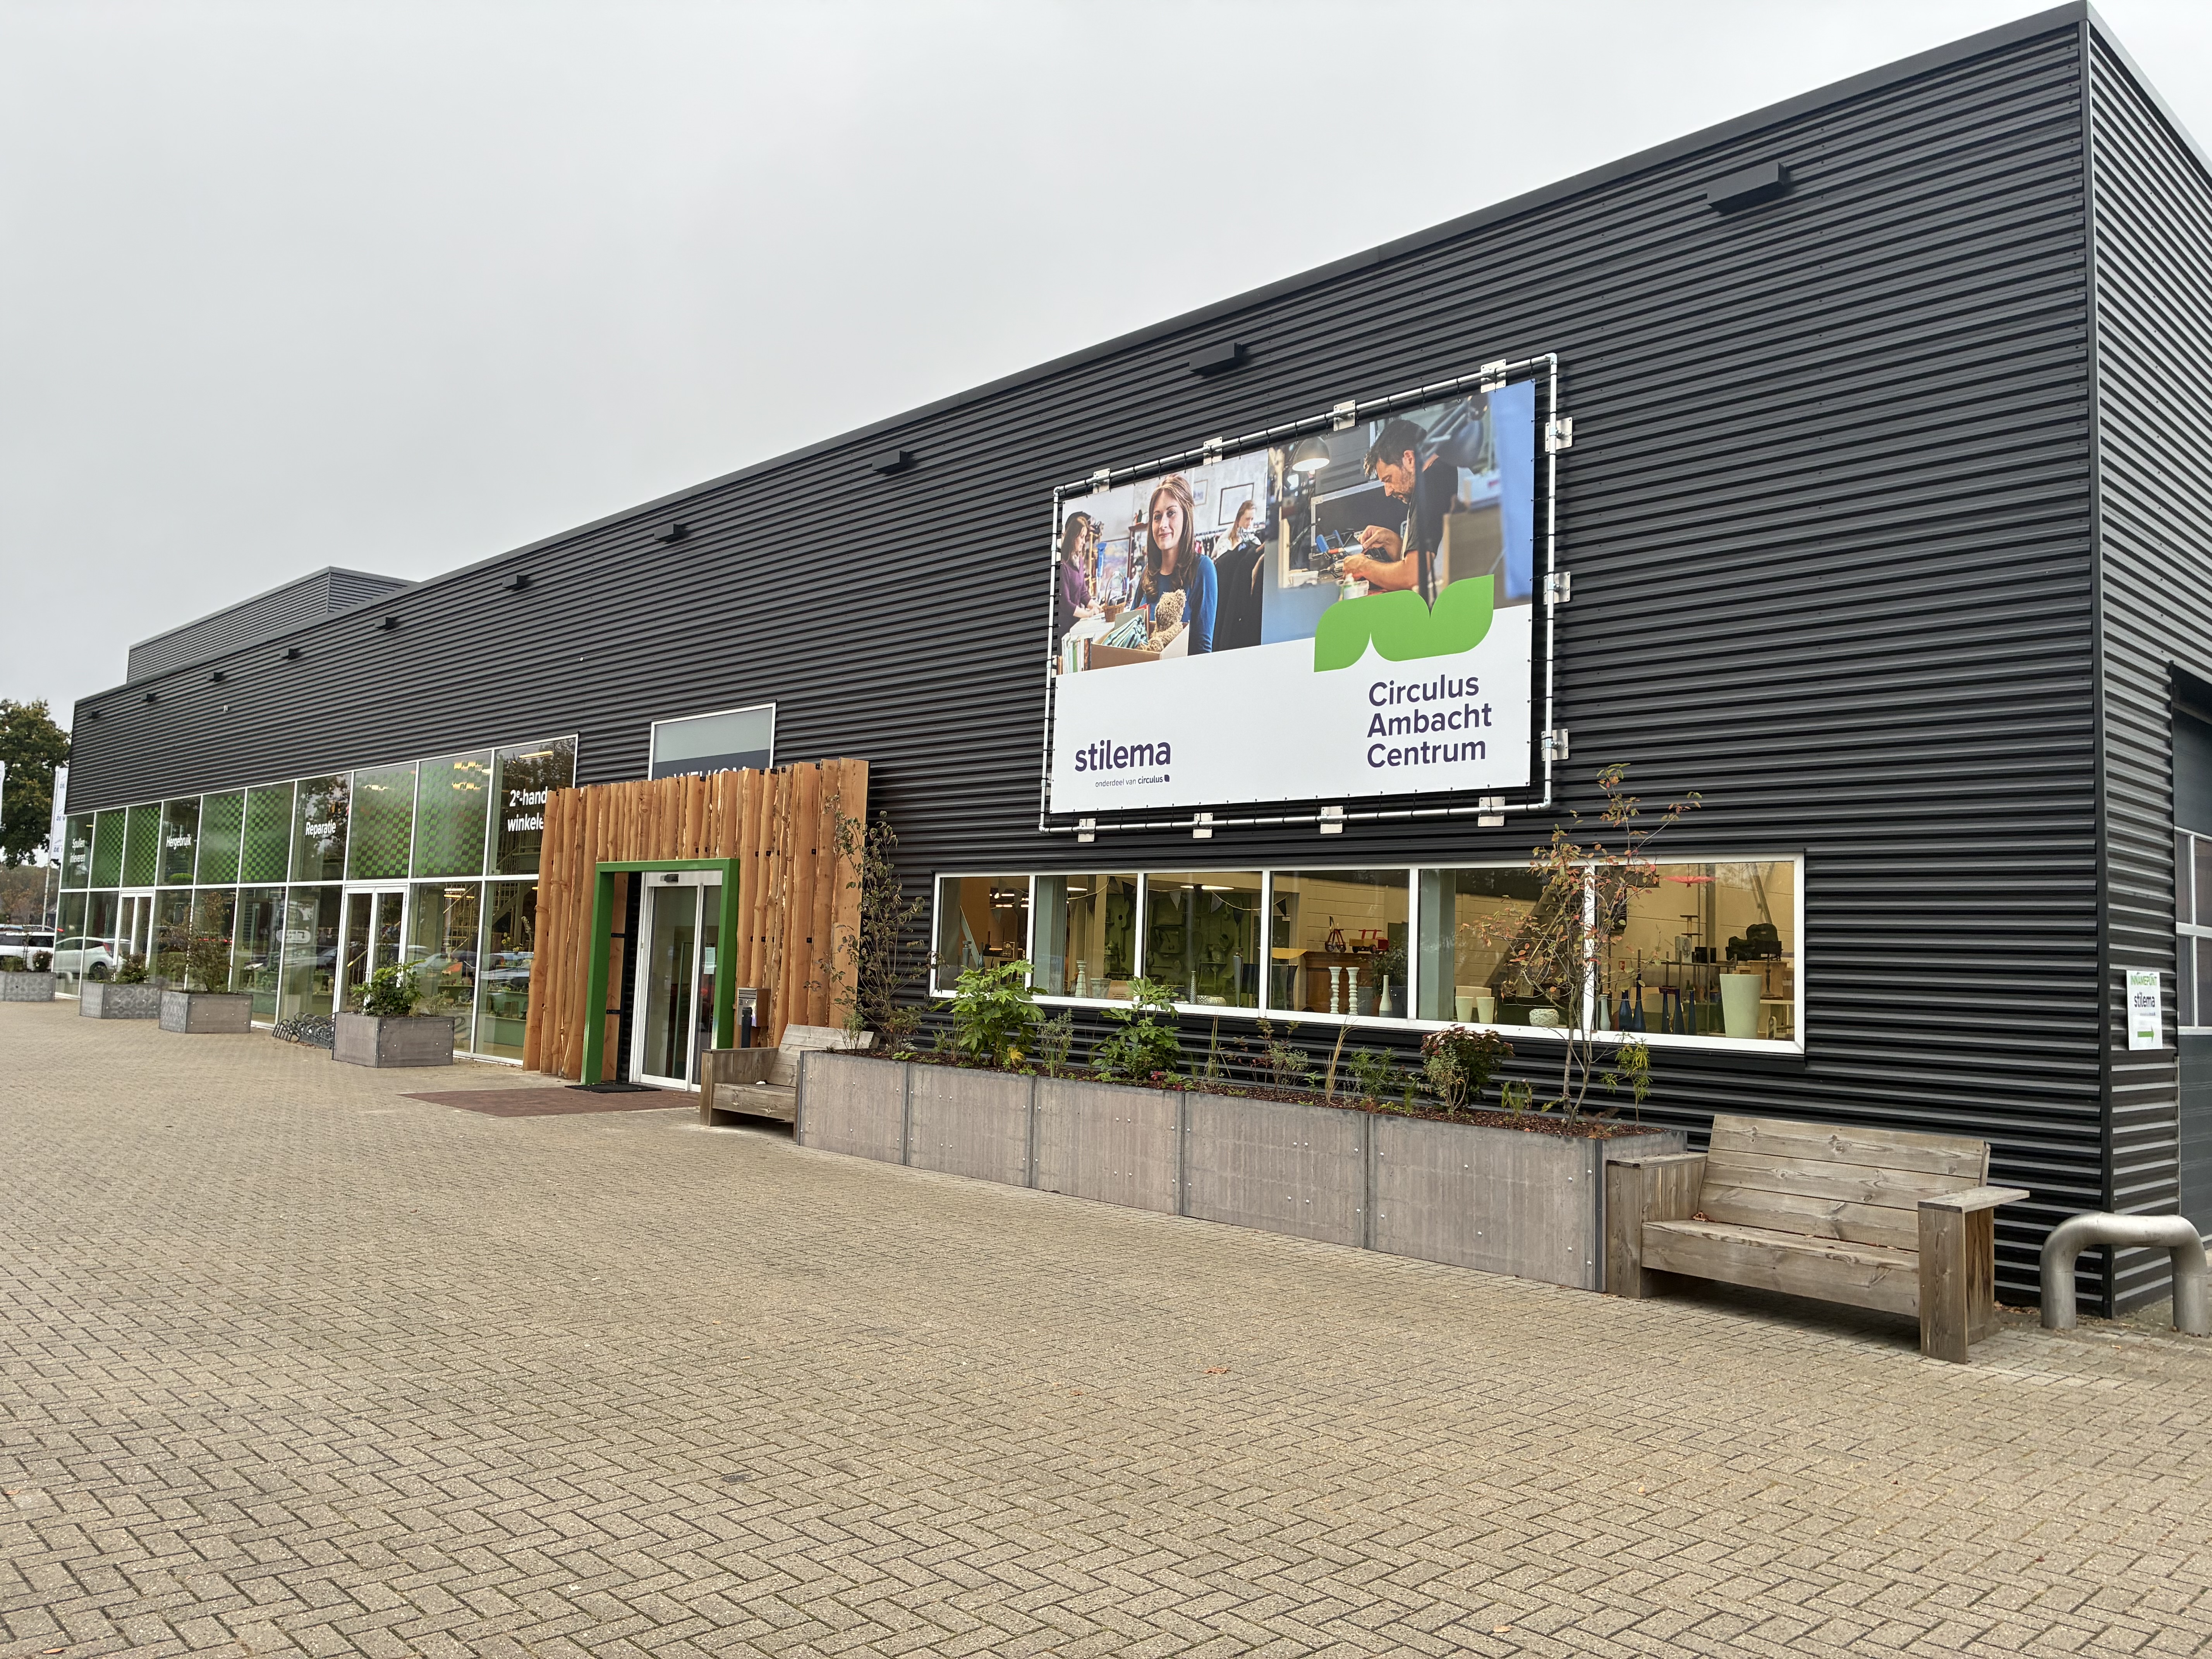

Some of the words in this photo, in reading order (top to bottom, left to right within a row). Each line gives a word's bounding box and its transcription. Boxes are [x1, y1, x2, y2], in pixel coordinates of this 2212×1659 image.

[1369, 674, 1479, 707] Circulus
[1367, 703, 1492, 738] Ambacht
[1075, 740, 1171, 772] stilema
[1367, 741, 1486, 768] Centrum
[1095, 779, 1124, 787] onderdeel
[1138, 775, 1163, 784] circulus
[305, 819, 336, 838] Reparatie
[166, 833, 191, 850] Hergebruik
[2134, 991, 2155, 1008] stilema
